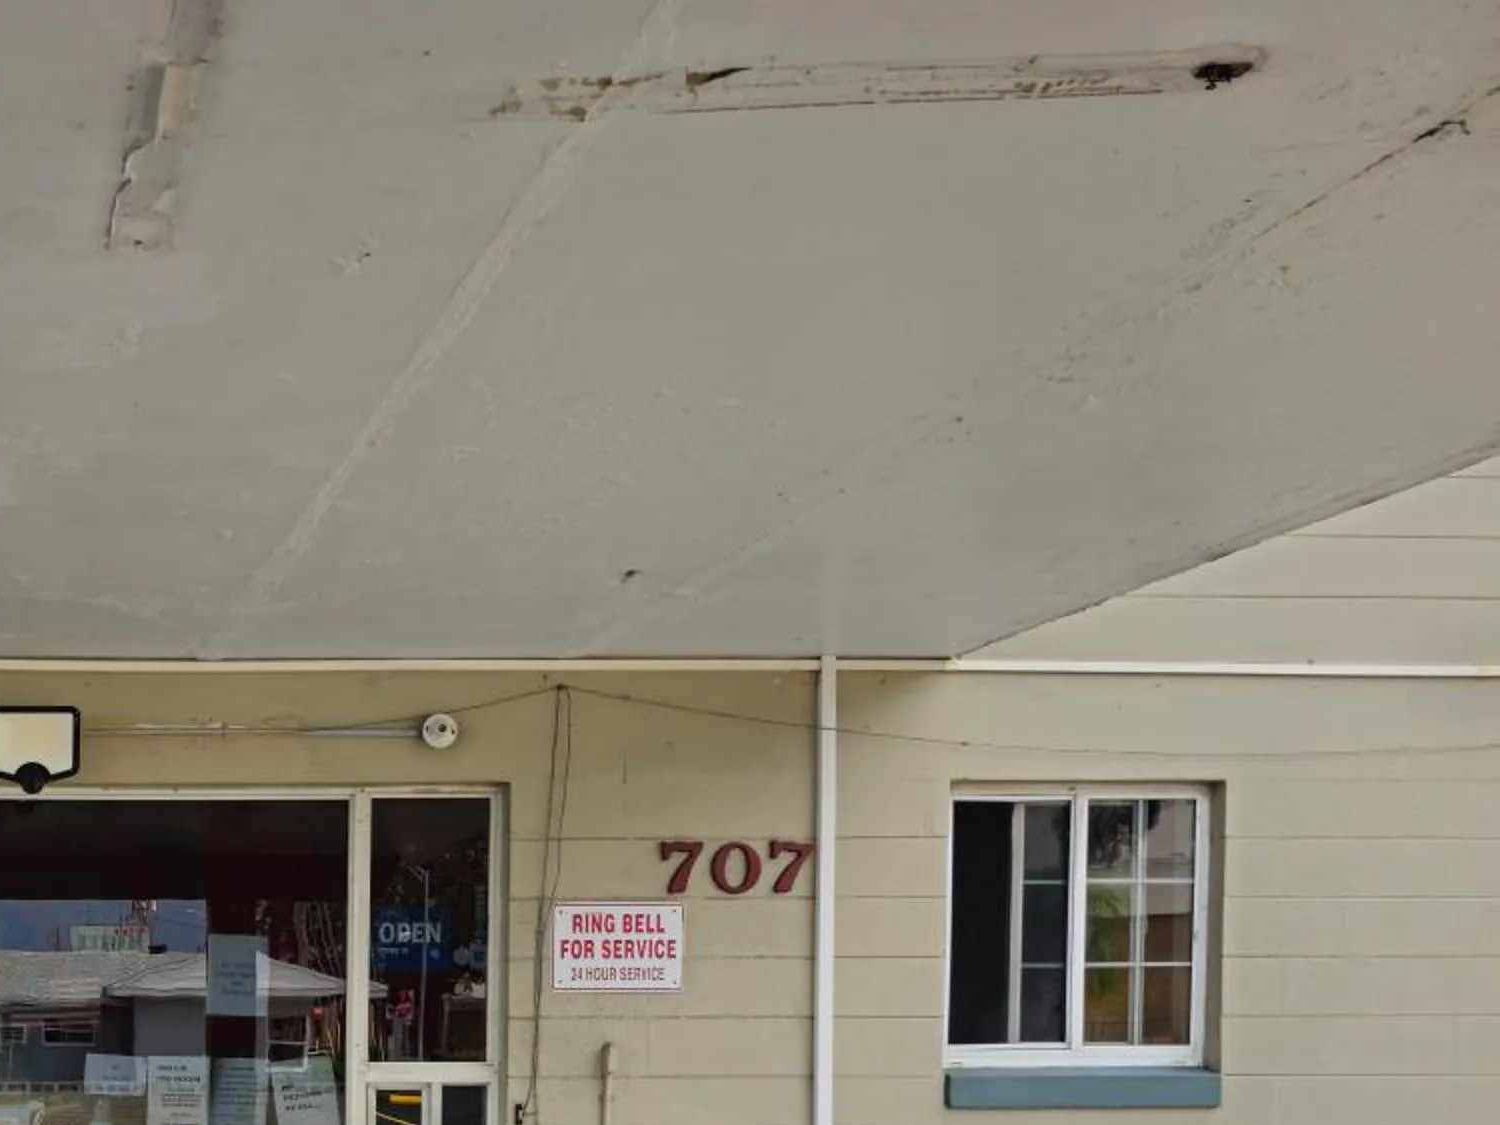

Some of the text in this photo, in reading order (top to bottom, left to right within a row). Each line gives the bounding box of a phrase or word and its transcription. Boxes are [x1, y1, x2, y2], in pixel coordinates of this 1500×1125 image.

[657, 840, 816, 894] 707
[378, 921, 442, 944] OPEN
[571, 913, 666, 934] RING BELL
[560, 939, 677, 960] FOR SERVICE
[585, 967, 617, 981] HOUR
[619, 967, 665, 981] SERVICE
